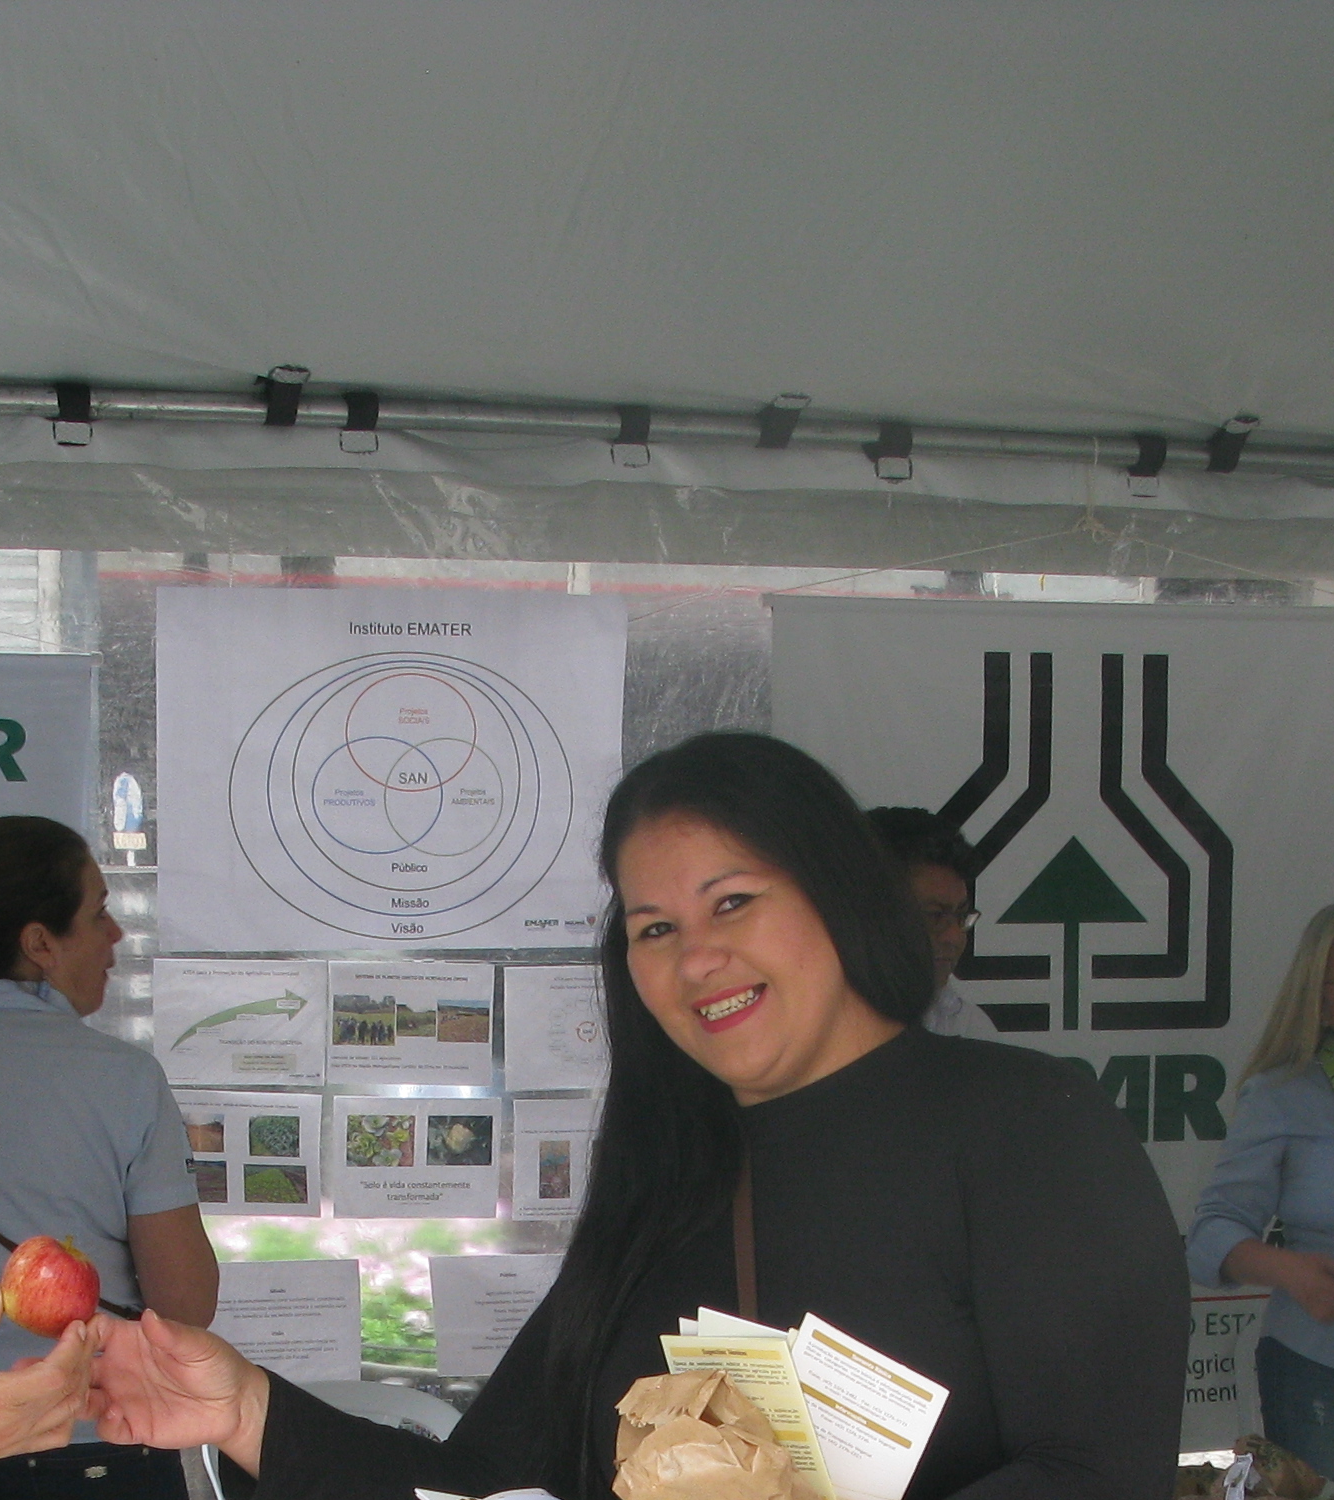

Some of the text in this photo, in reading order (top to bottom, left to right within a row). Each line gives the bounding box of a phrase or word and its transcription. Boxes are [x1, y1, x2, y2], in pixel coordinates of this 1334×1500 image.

[349, 622, 472, 636] Instituto EMATER
[399, 772, 428, 784] SAN
[391, 863, 428, 873] Público
[391, 898, 429, 908] Missão
[391, 923, 424, 934] Visão
[389, 1181, 405, 1189] vida
